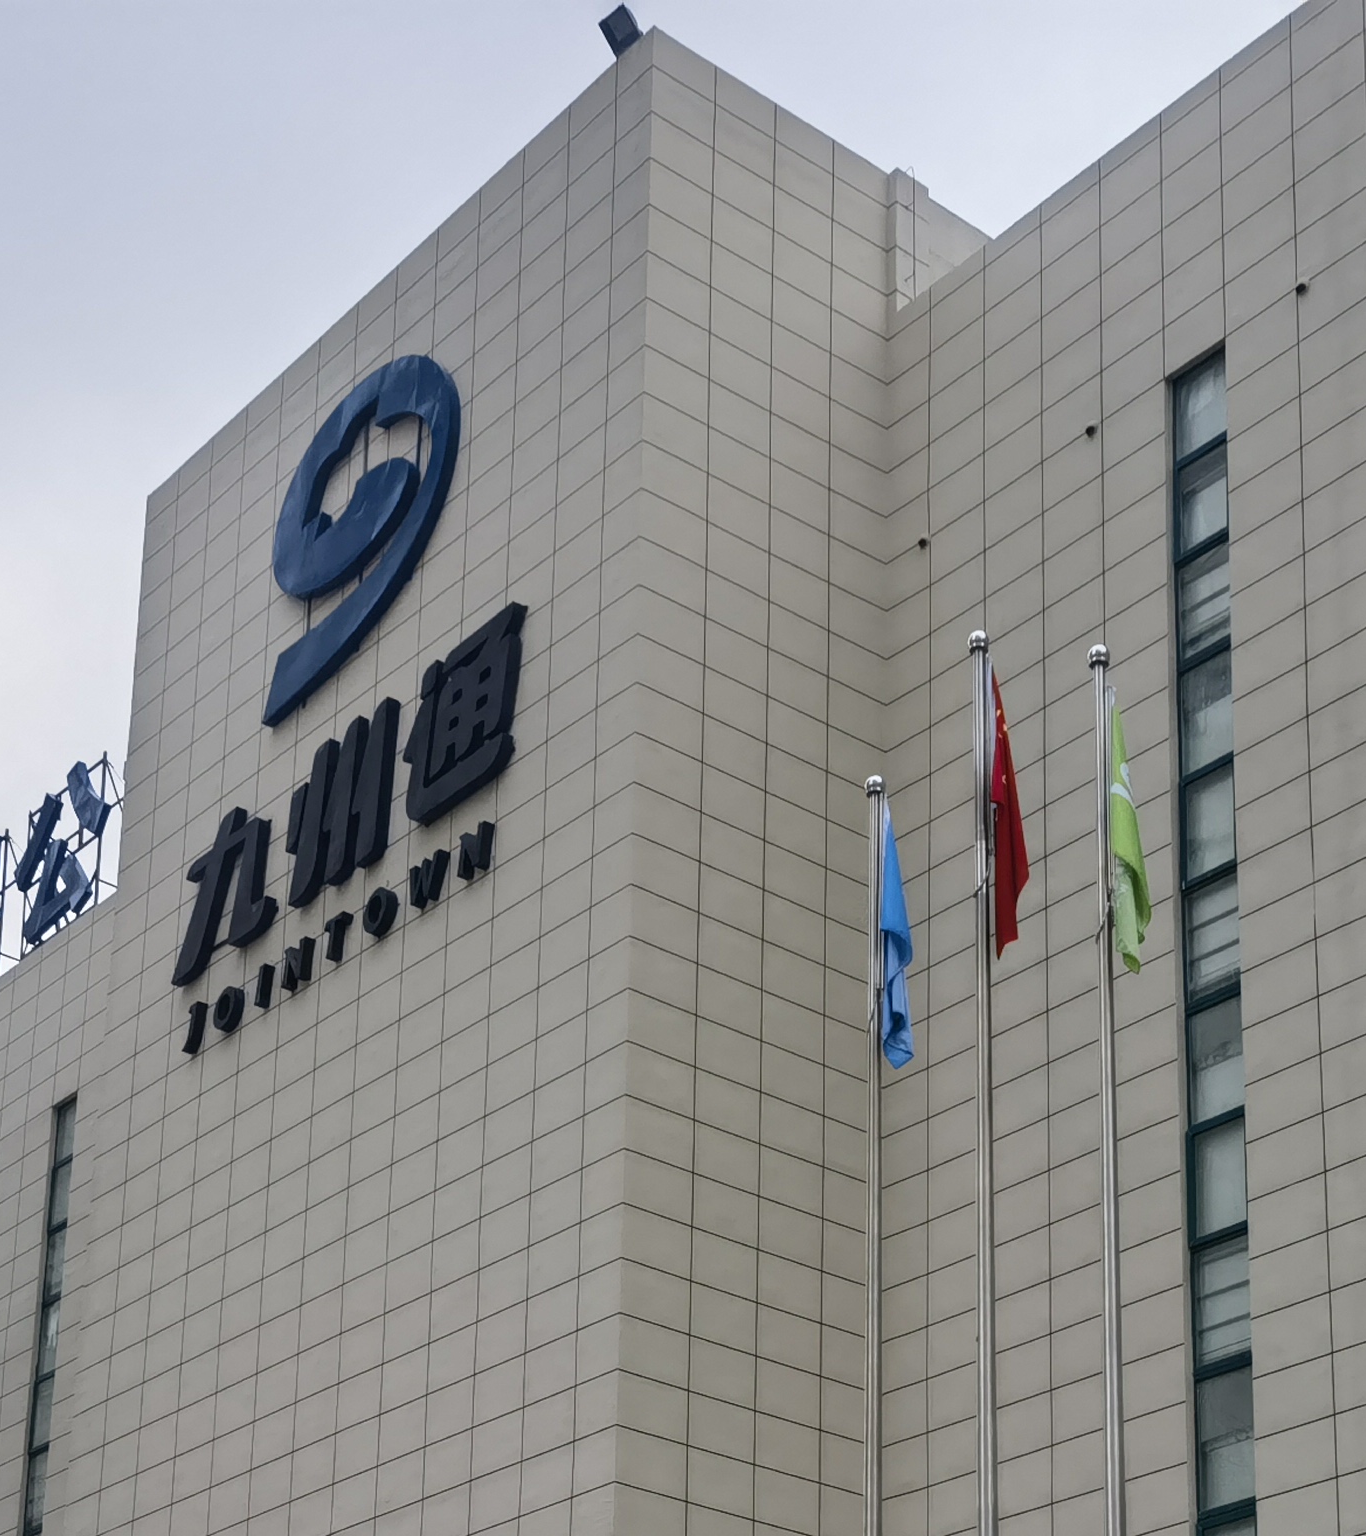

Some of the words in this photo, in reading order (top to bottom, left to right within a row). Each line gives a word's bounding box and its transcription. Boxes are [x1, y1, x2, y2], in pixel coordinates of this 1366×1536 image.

[171, 602, 528, 987] 九州通
[181, 820, 495, 1055] JOINTOWN
